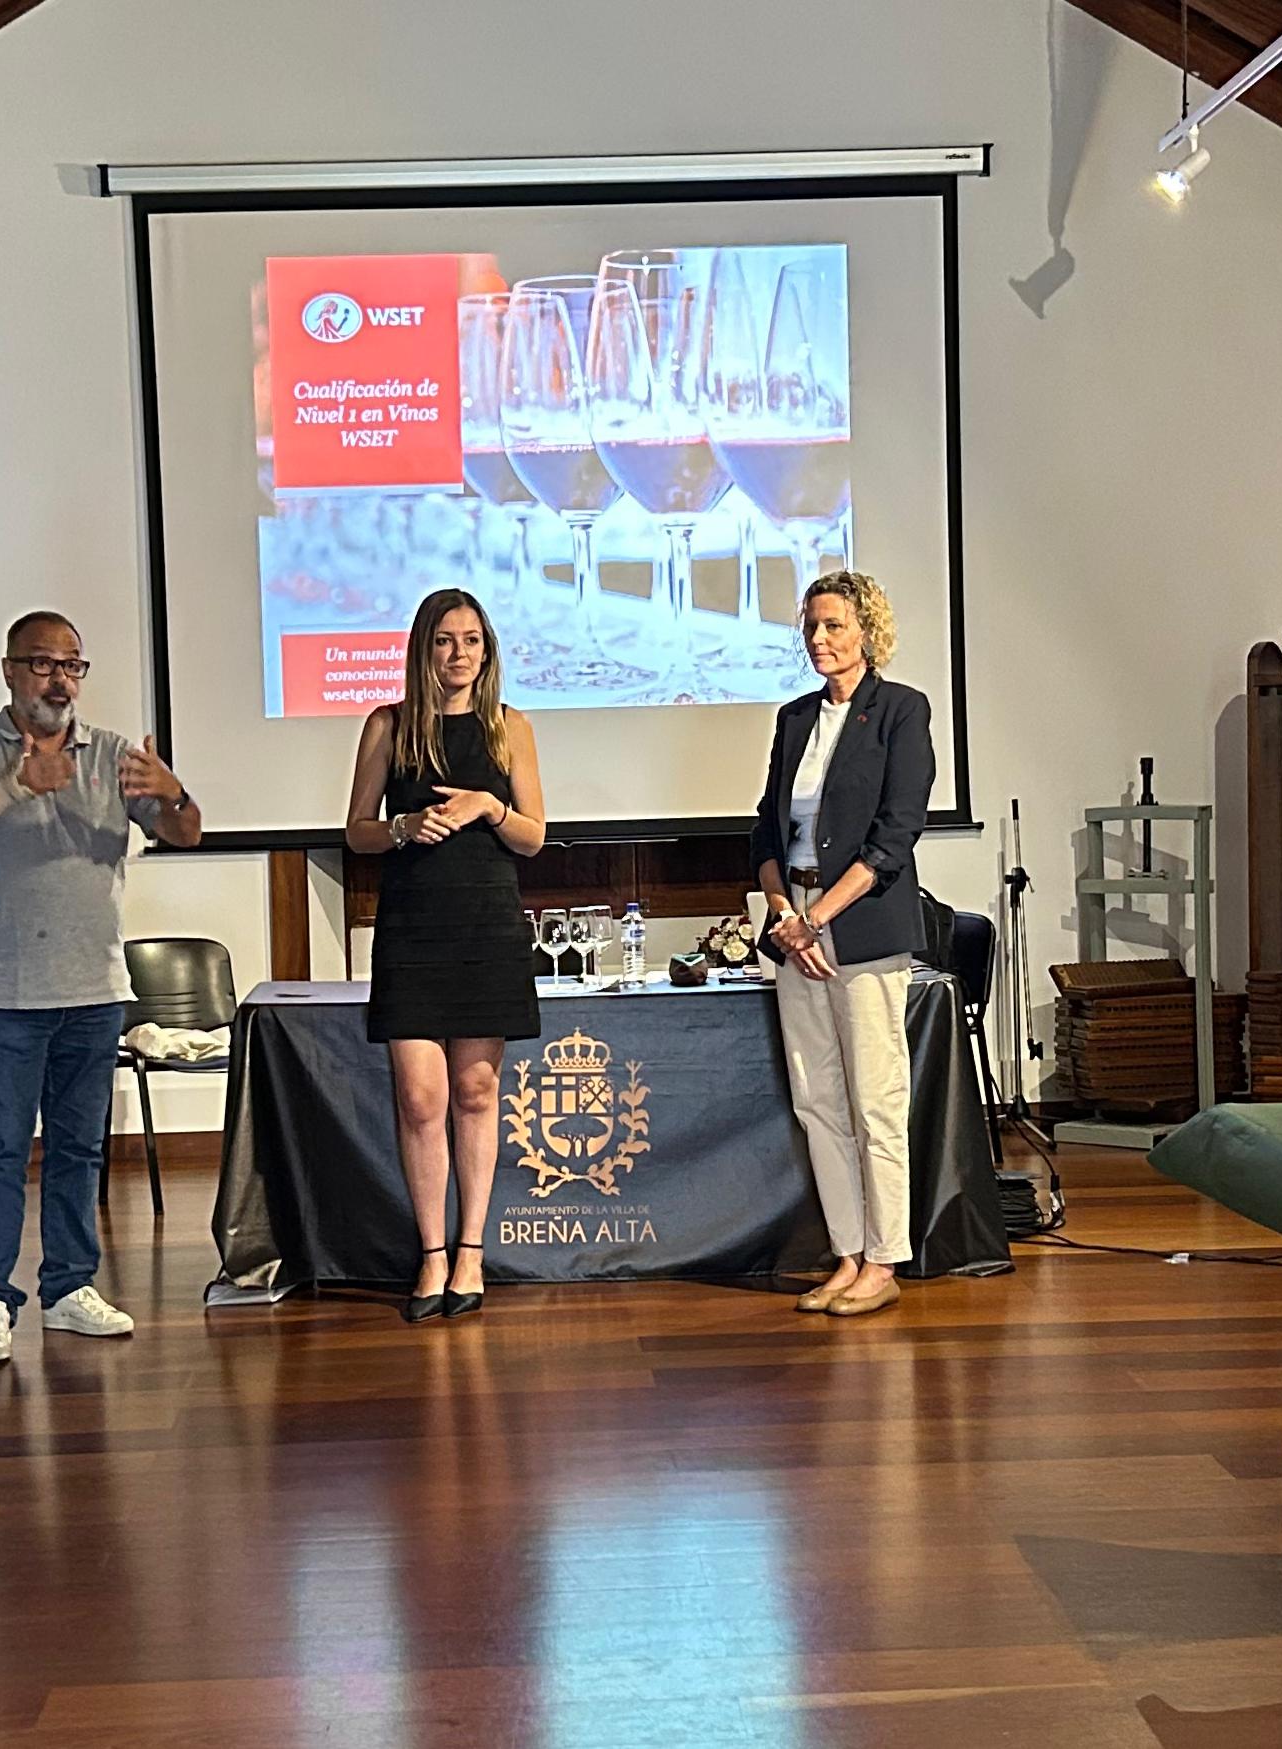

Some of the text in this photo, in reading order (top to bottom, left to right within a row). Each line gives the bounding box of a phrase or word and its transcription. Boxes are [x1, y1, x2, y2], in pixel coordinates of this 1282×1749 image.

[366, 306, 425, 327] WSET
[293, 378, 440, 403] Cualificación de
[294, 403, 439, 425] Nivel 1 en Vinos
[340, 429, 400, 448] WSET
[324, 644, 404, 662] Un mundo
[504, 1204, 650, 1216] AYUNTAMIENTO DE LA VILLA DE
[499, 1215, 658, 1245] BREÑA ALTA
